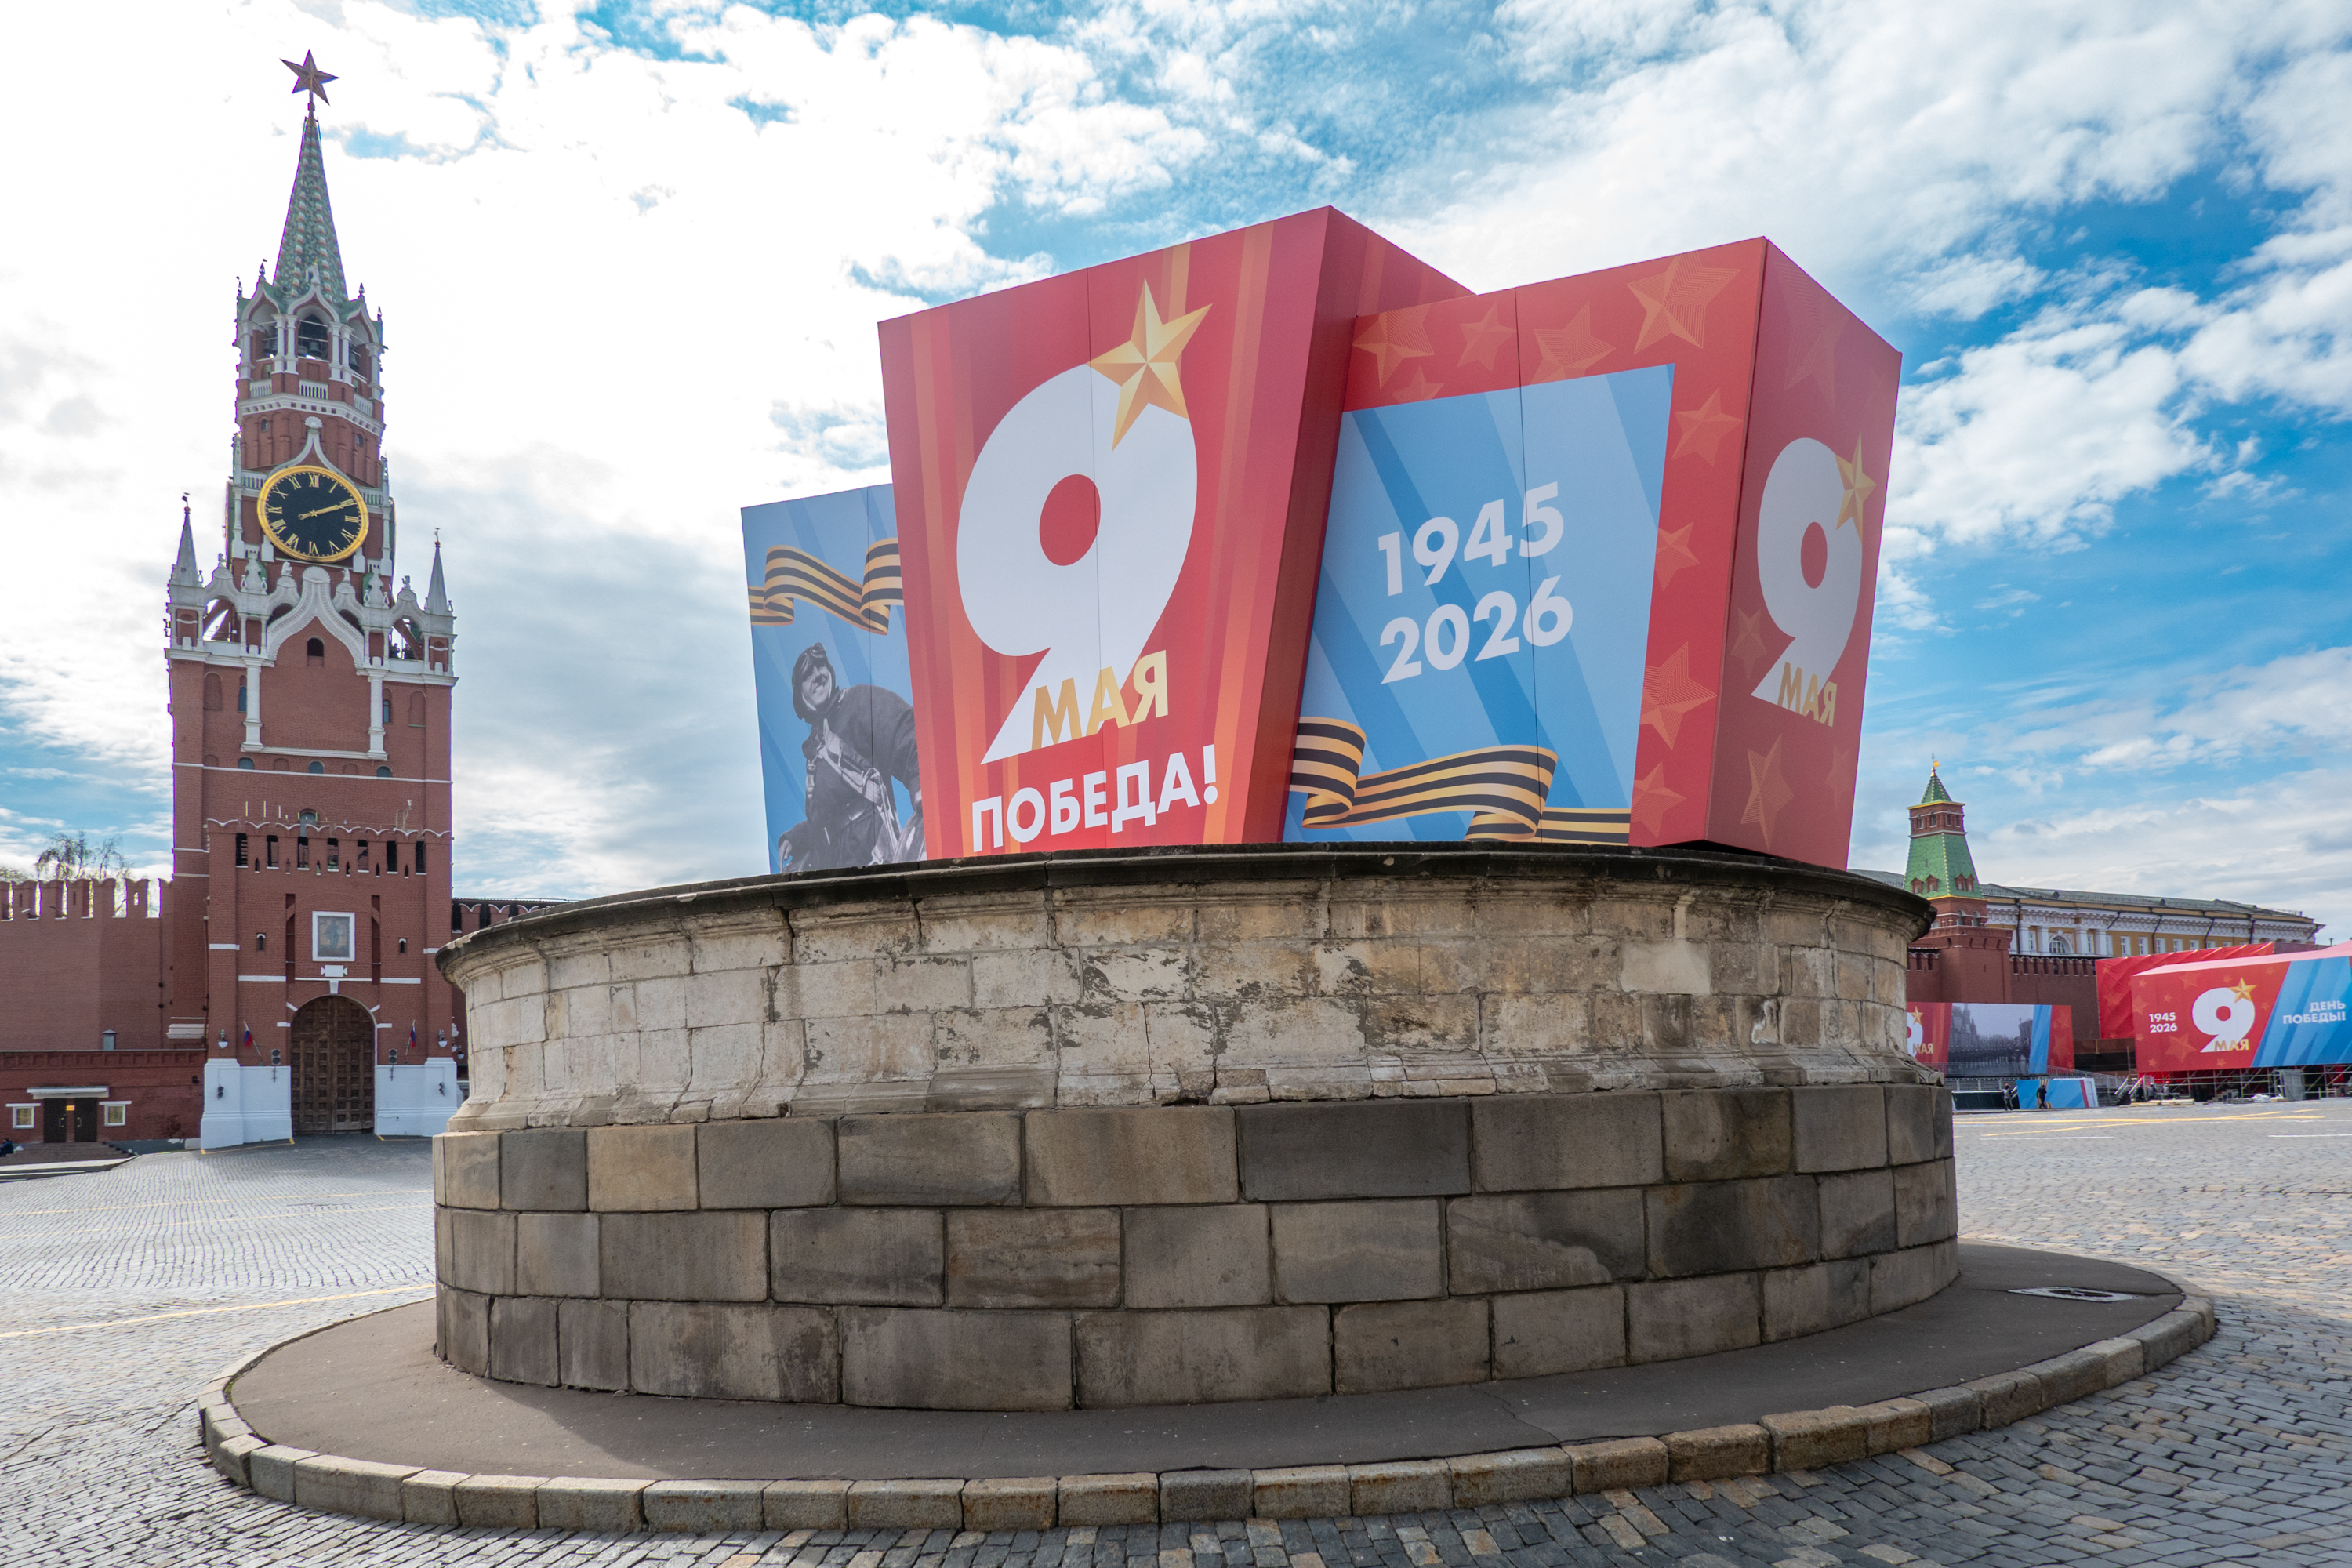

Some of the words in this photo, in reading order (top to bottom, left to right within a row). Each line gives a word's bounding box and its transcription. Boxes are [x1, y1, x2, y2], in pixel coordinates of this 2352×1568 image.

[272, 487, 289, 499] X
[309, 472, 319, 488] XII
[1377, 481, 1565, 597] 1945
[956, 364, 1198, 765] 9
[1751, 437, 1864, 716] 9
[1380, 575, 1573, 684] 2026
[1032, 650, 1168, 750] МАЯ
[1779, 662, 1838, 728] МАЯ
[971, 744, 1219, 853] ПОБЕДА!
[2148, 1012, 2176, 1022] 1945
[2192, 987, 2255, 1053] 9
[2282, 1011, 2347, 1025] ПОБЕДЫ!
[2310, 1000, 2346, 1013] ДЕНЬ
[1912, 1043, 1934, 1054] МАЯ
[2150, 1023, 2178, 1033] 2026
[2213, 1039, 2249, 1052] МАЯ
